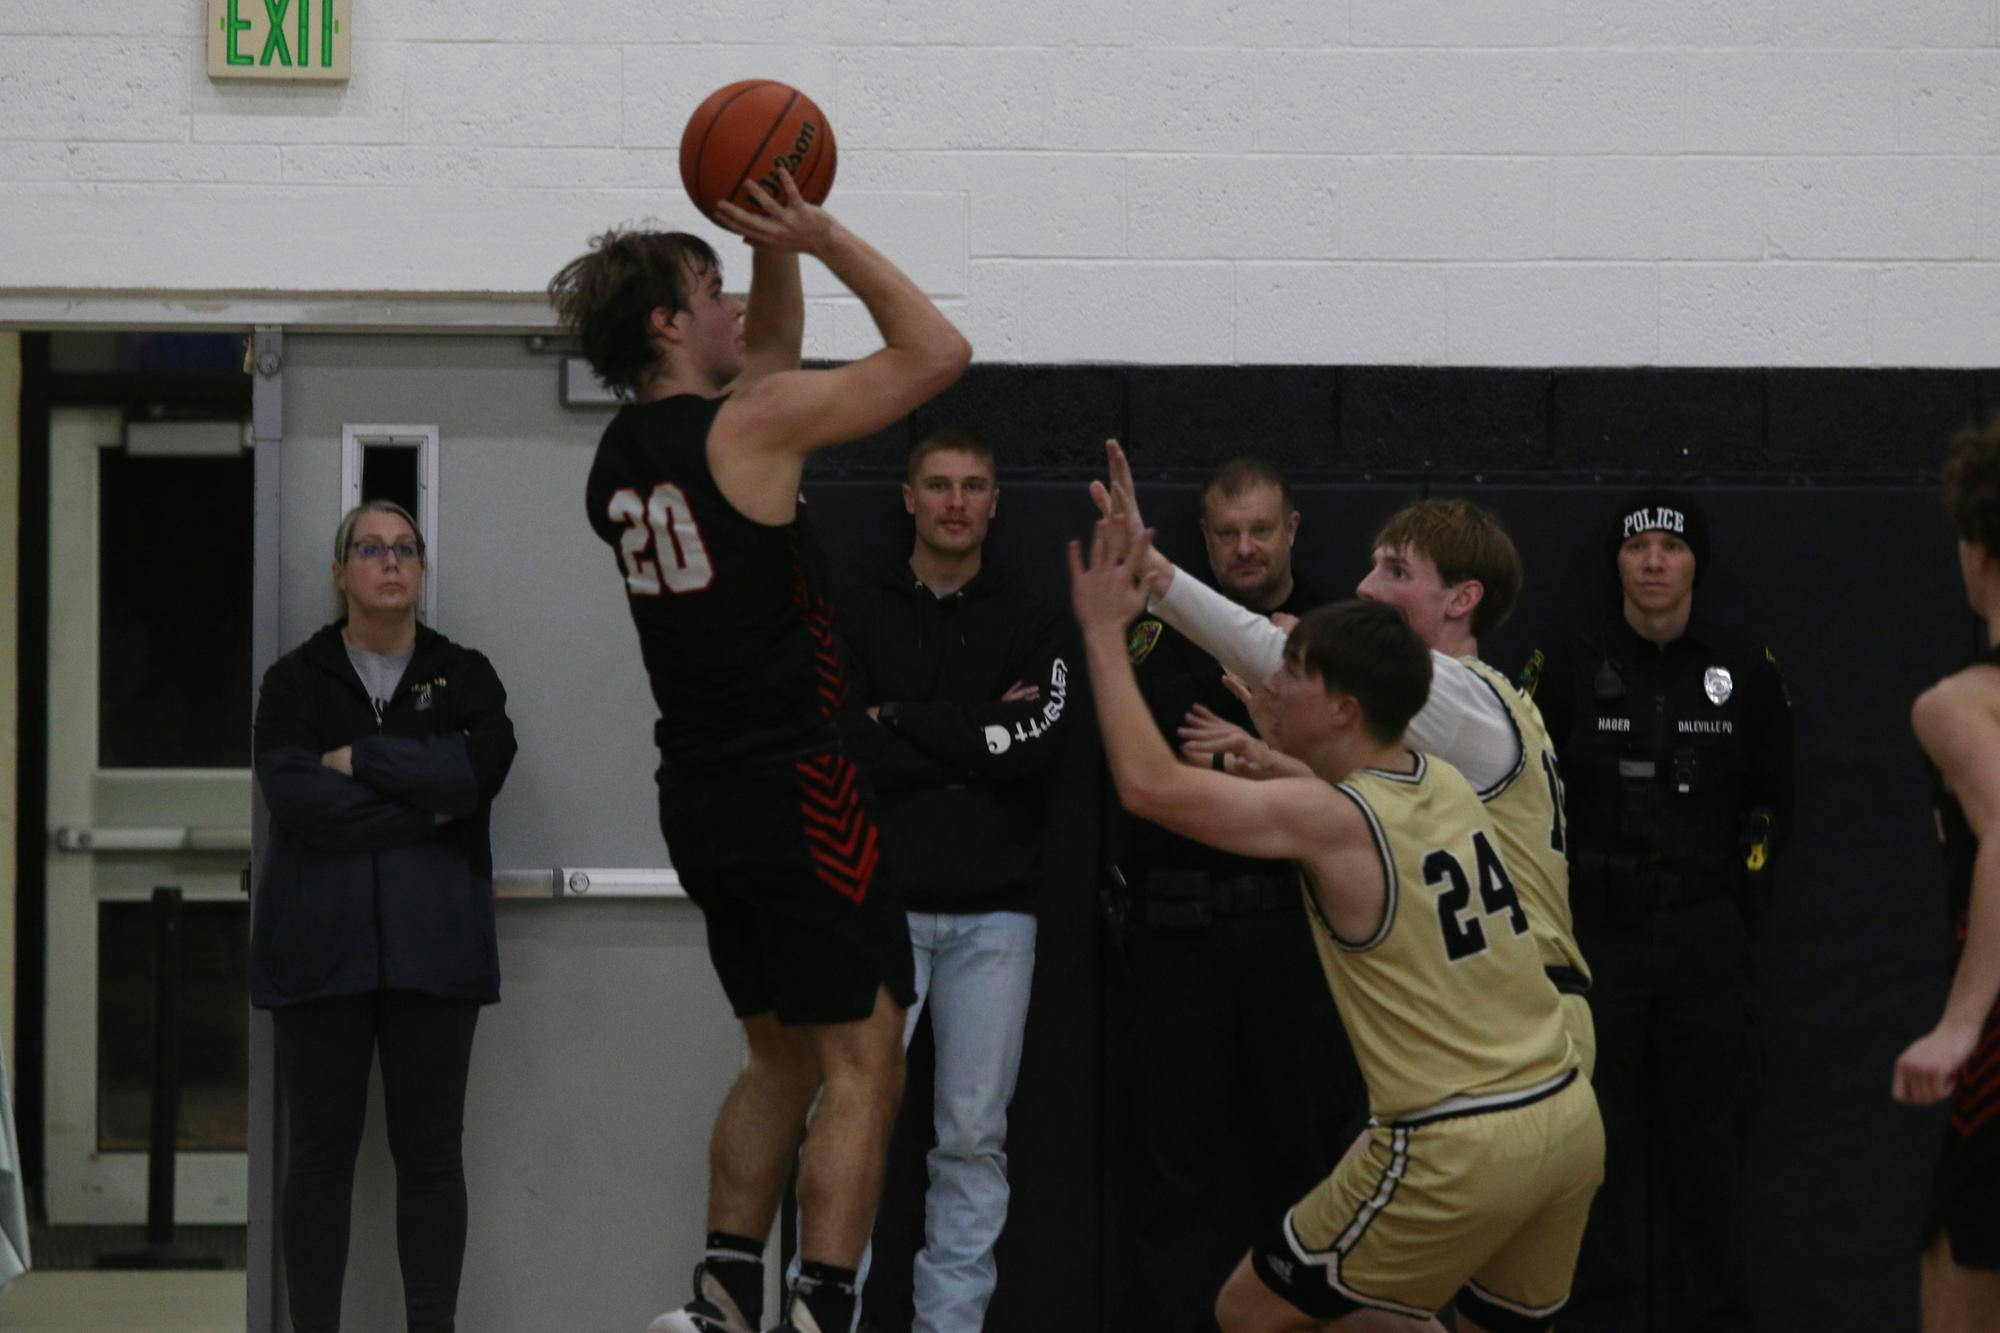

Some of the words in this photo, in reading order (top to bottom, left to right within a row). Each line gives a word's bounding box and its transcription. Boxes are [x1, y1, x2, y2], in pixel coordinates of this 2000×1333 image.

[1623, 506, 1684, 538] POLICE
[608, 482, 715, 595] 20
[1598, 717, 1631, 732] HAGER
[1678, 720, 1721, 733] DALEVILLE
[1422, 830, 1530, 962] 24
